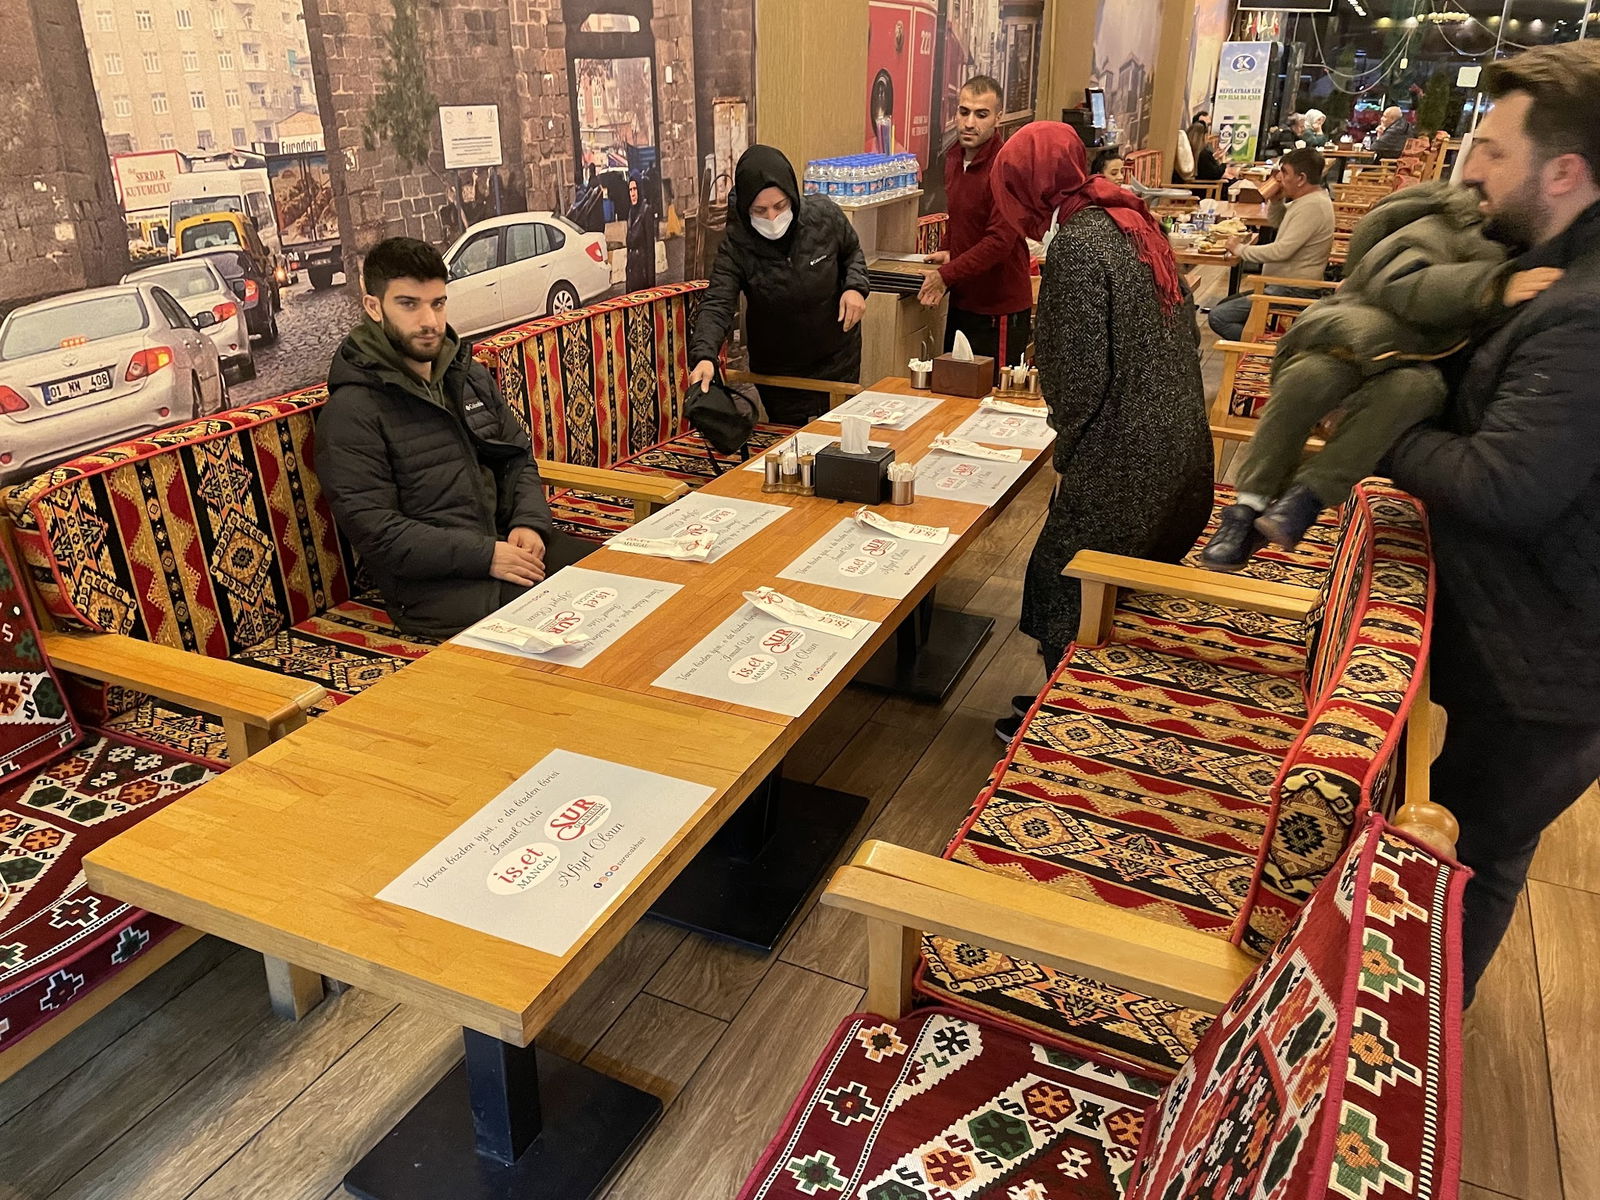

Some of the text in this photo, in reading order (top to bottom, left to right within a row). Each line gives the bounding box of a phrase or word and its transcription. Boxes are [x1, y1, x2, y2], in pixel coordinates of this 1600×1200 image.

[136, 169, 166, 183] SERDAR
[49, 385, 62, 398] 01
[91, 373, 109, 388] 408
[762, 628, 793, 654] SUR
[549, 798, 597, 841] SUR
[412, 865, 449, 889] Varsa
[444, 842, 476, 866] bizden
[503, 808, 517, 818] da
[513, 786, 541, 807] bizden
[516, 855, 558, 890] MANGAL
[558, 822, 626, 889] Afiyet Olsun
